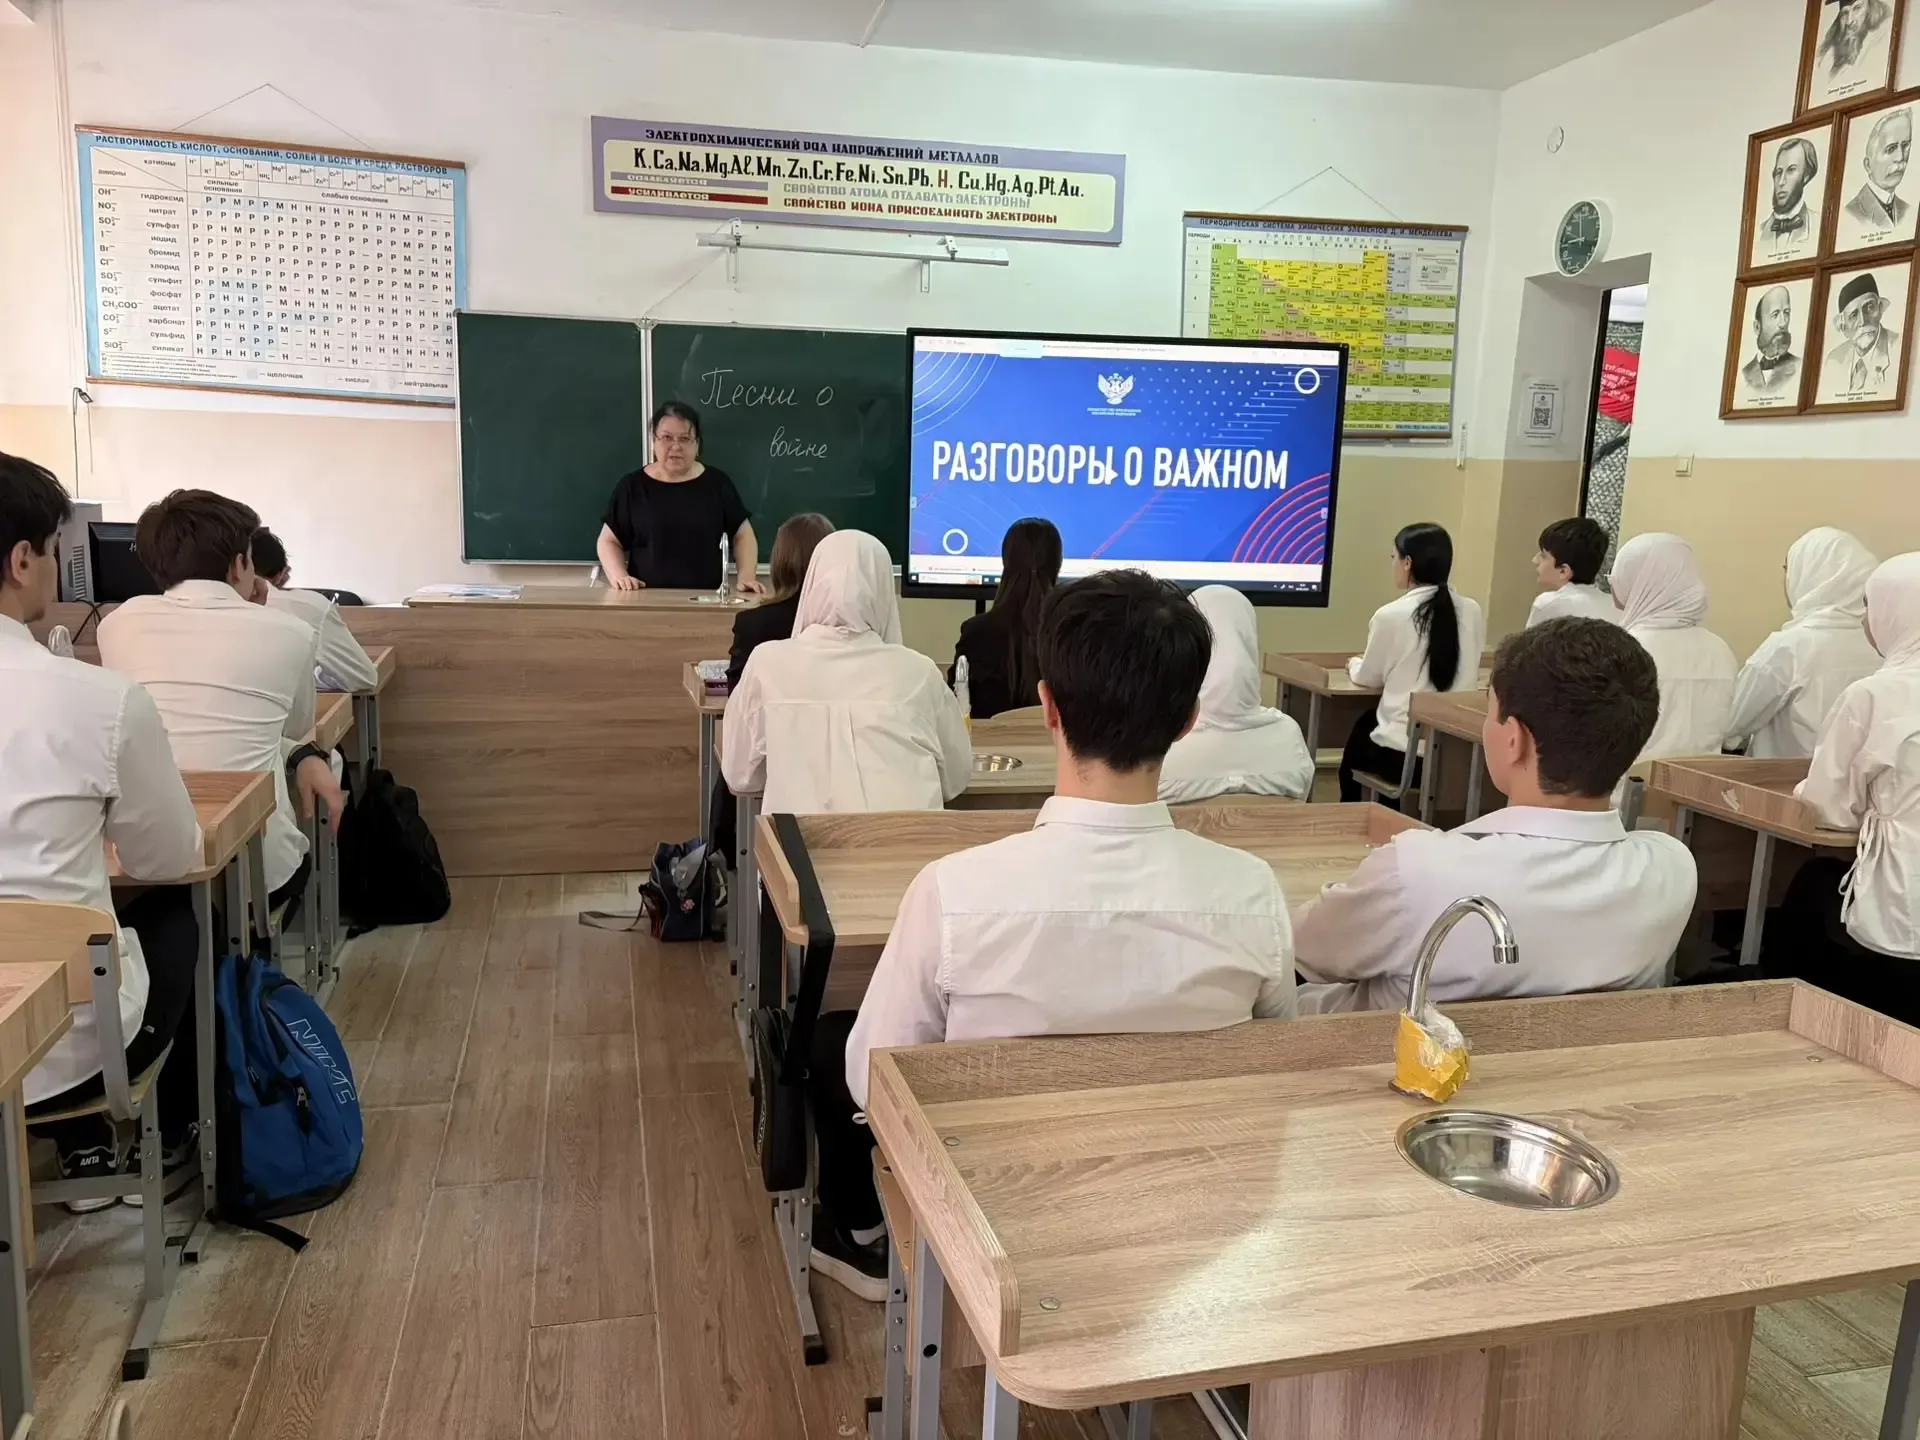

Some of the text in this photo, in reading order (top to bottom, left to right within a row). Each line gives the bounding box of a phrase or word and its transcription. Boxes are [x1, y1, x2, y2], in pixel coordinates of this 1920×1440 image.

[645, 129, 999, 165] ЭЛЕКТРОХИМИЧЕСКИЙ РЯД НАПРЯЖЕНИЙ МЕТАЛЛОВ
[96, 135, 178, 150] РАСТВОРИМОСТЬ
[181, 143, 220, 155] КИСЛОТ,
[223, 145, 283, 159] ОСНОВАНИЙ,
[286, 151, 317, 161] СОЛЕЙ
[328, 157, 353, 166] ВОДЕ
[363, 160, 393, 170] СРЕДА
[396, 162, 448, 175] РАСТВОРОВ
[144, 159, 176, 167] катионы
[203, 186, 243, 194] основания
[783, 181, 1031, 208] СВОЙСТВО АТОМА ОТДАВАТЬ ЭЛЕКТРОНЫ
[140, 193, 184, 203] гидроксид
[149, 208, 177, 216] нитрат
[783, 196, 1057, 224] СВОЙСТВО ИОНА ПРИСОЕДИНЯТЬ ЭЛЕКТРОНЫ
[146, 221, 180, 231] сульфат
[1199, 218, 1260, 228] ПЕРИОДИЧЕСКАЯ
[1262, 221, 1295, 230] СИСТЕМА
[1298, 223, 1344, 232] ХИМИЧЕСКИХ
[1347, 226, 1388, 234] ЭЛЕМЕНТОВ
[1408, 228, 1453, 238] МЕНДЕЛЕЕВА
[148, 248, 181, 258] бромид
[150, 263, 180, 272] хлорид
[148, 277, 183, 286] сульфит
[150, 290, 182, 299] фосфат
[153, 304, 180, 312] ацетат
[148, 317, 185, 326] карбонат
[150, 331, 186, 340] сульфид
[152, 345, 184, 353] силикат
[701, 367, 833, 409] Песни о
[769, 426, 828, 459] войне
[931, 440, 1289, 490] РАЗГОВОРЫ О ВАЖНОМ
[80, 1155, 99, 1167] ANTA
